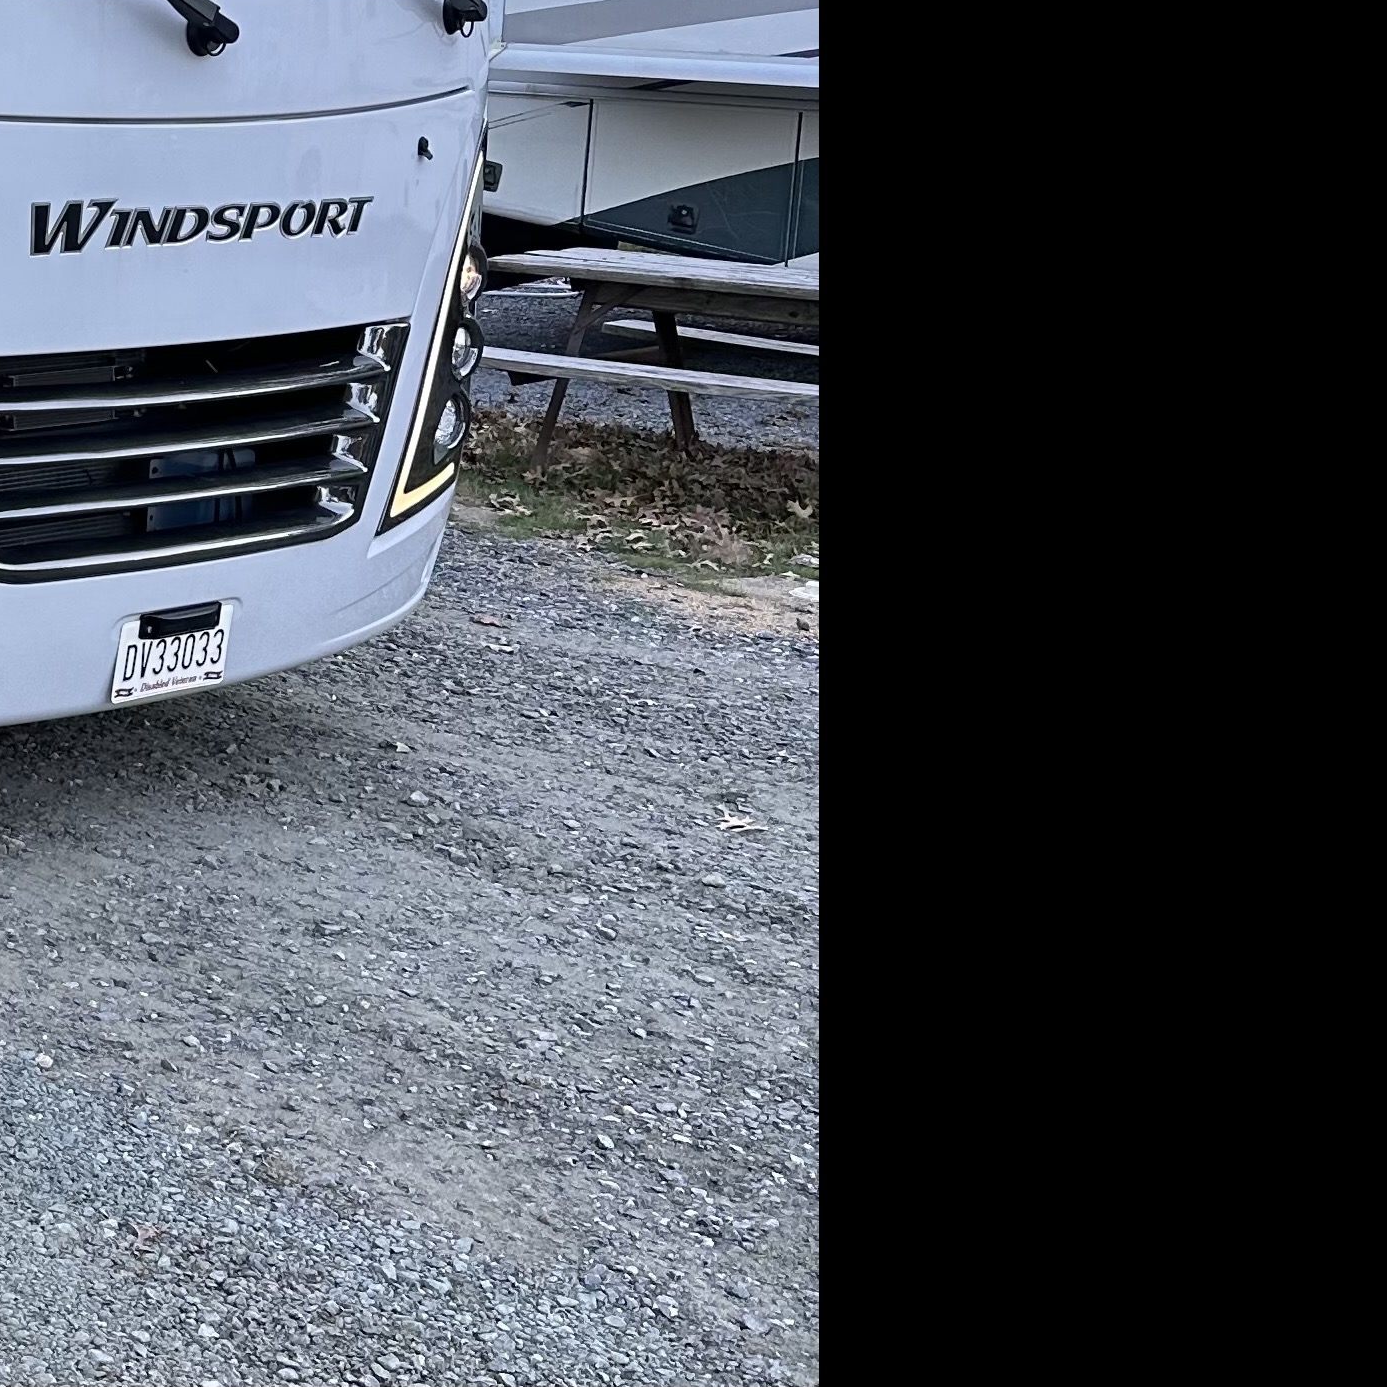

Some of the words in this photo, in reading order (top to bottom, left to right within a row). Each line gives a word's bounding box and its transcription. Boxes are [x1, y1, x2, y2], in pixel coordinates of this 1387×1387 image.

[29, 196, 375, 257] WINDSPORT
[122, 629, 225, 682] DV33033
[139, 677, 171, 693] Disabled
